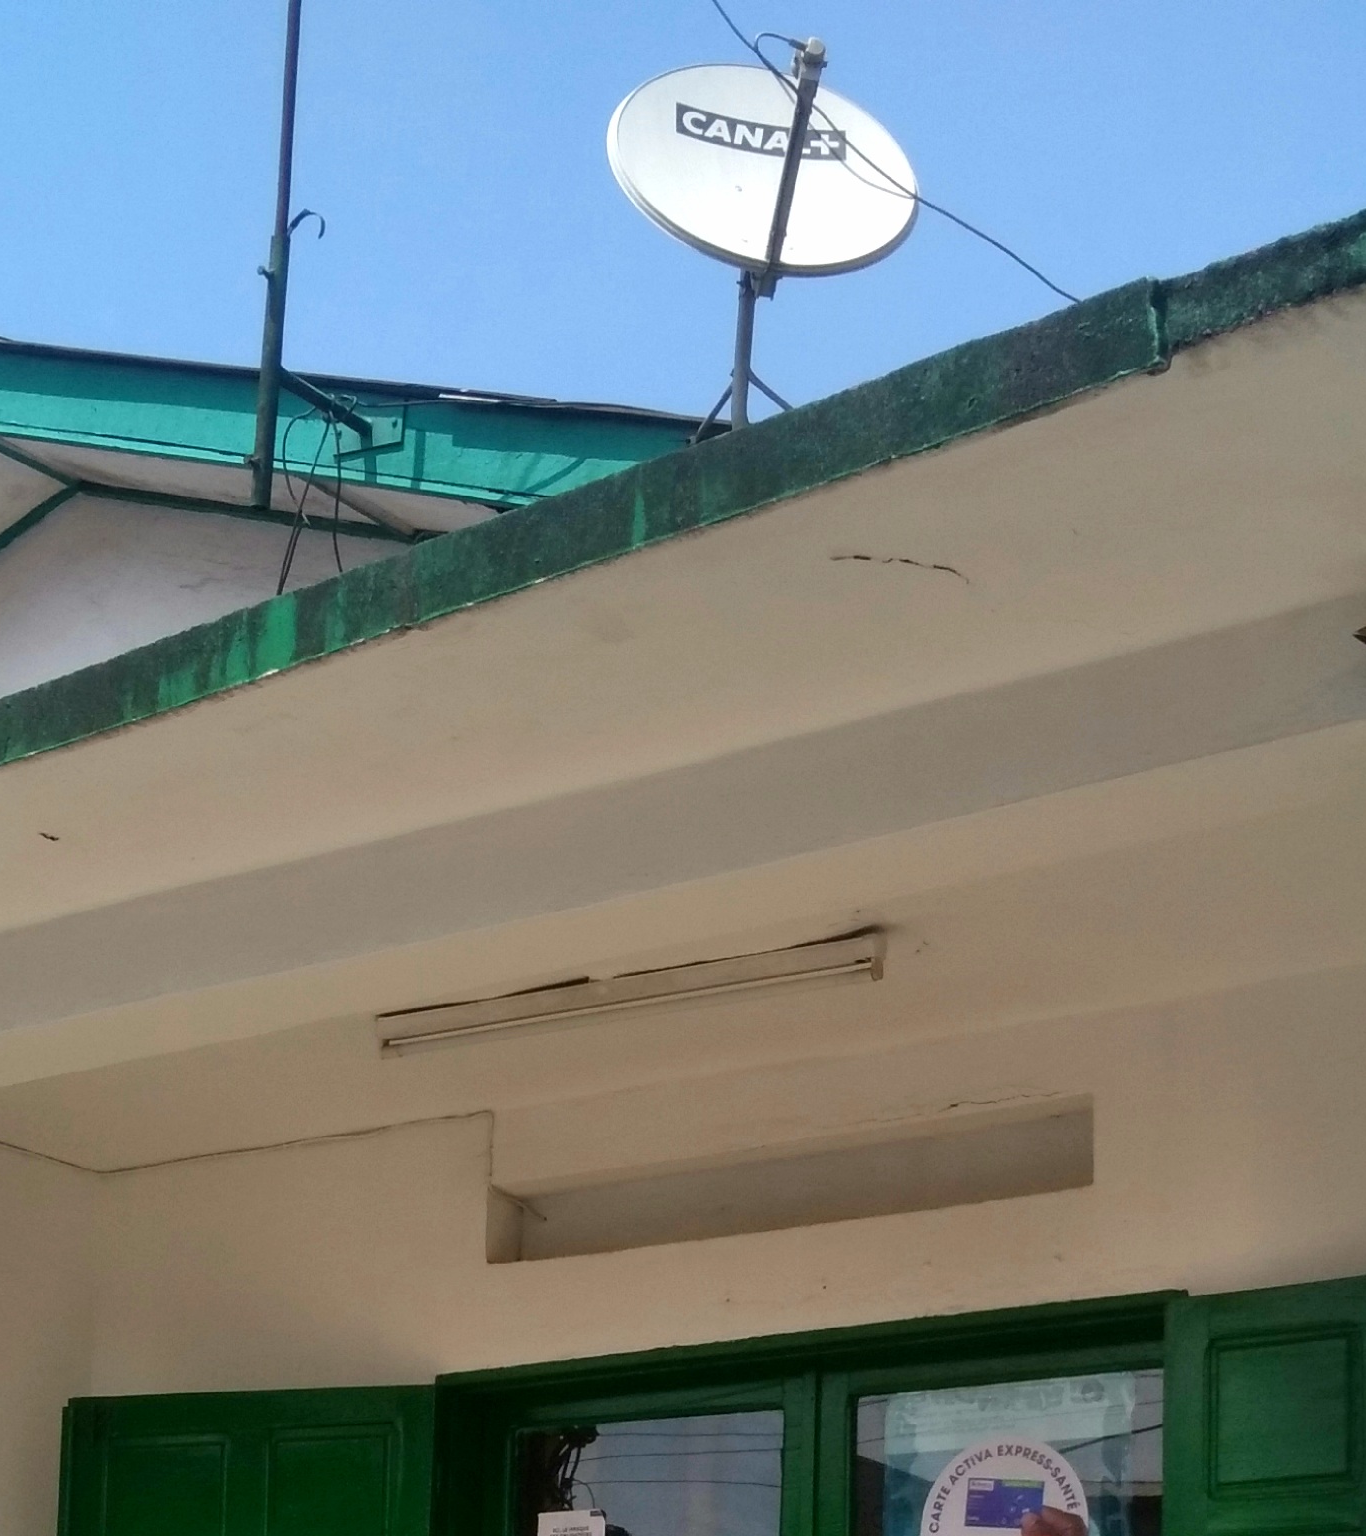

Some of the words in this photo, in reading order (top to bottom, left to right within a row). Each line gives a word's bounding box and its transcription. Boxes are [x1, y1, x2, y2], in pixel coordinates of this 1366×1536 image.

[928, 1485, 952, 1534] CARTE
[948, 1449, 993, 1486] ACTIVA
[997, 1444, 1080, 1510] EXPRESS-SANTÉ
